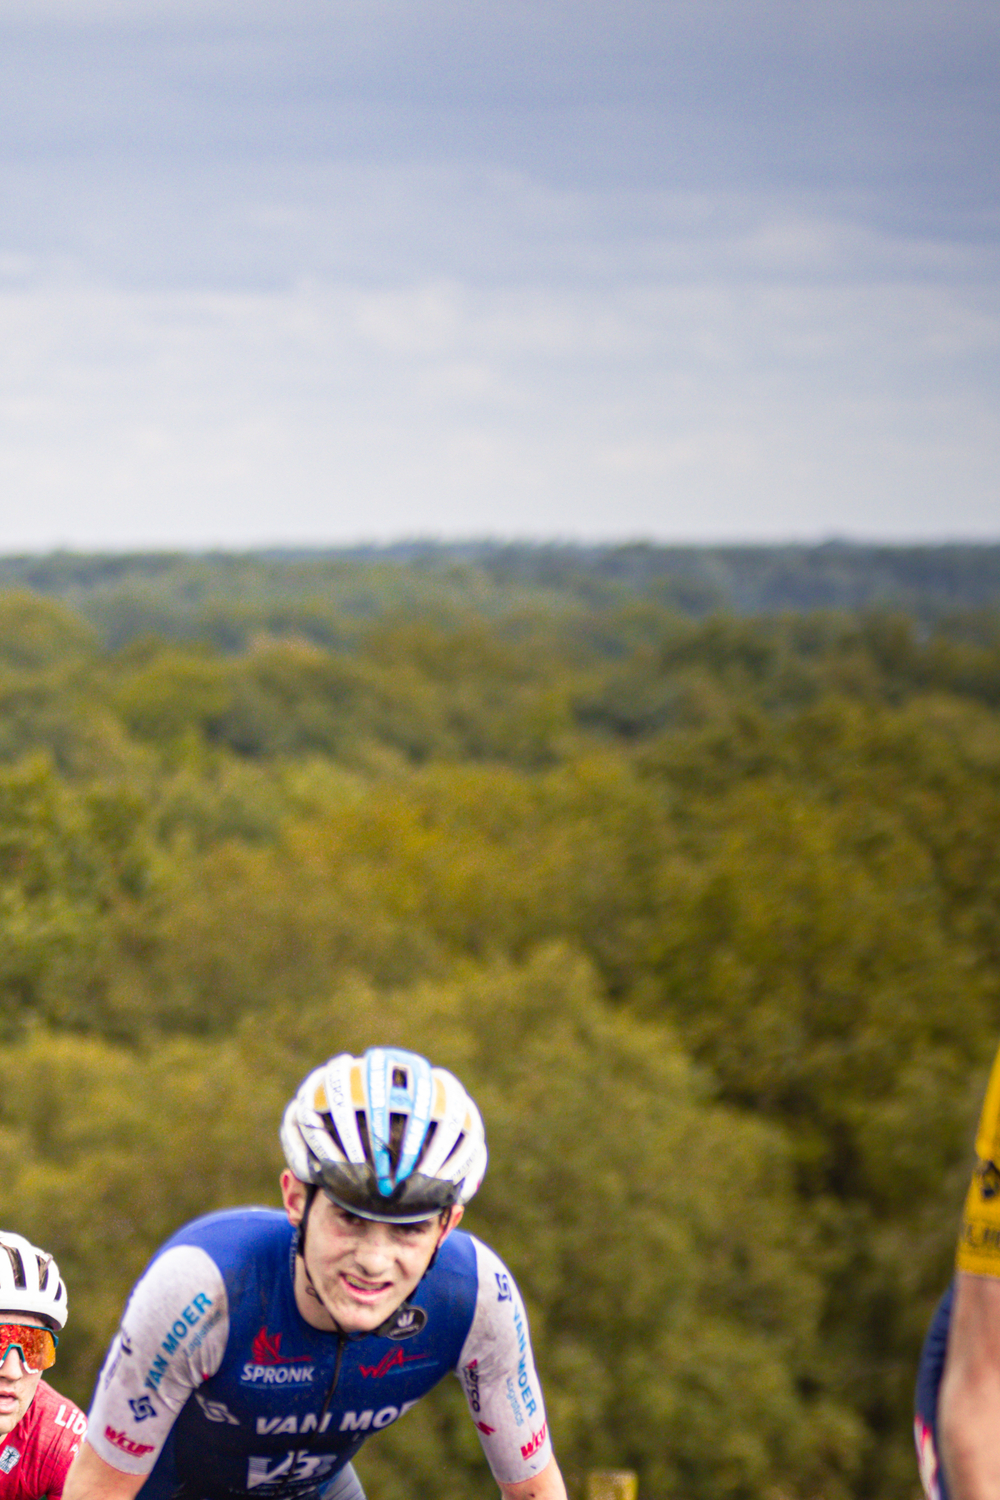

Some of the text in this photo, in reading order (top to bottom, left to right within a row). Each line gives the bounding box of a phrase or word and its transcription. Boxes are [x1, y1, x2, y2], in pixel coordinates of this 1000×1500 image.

[162, 1292, 213, 1356] MOER
[241, 1364, 314, 1384] SPRONK
[517, 1353, 538, 1418] MOER
[256, 1411, 333, 1435] VAN
